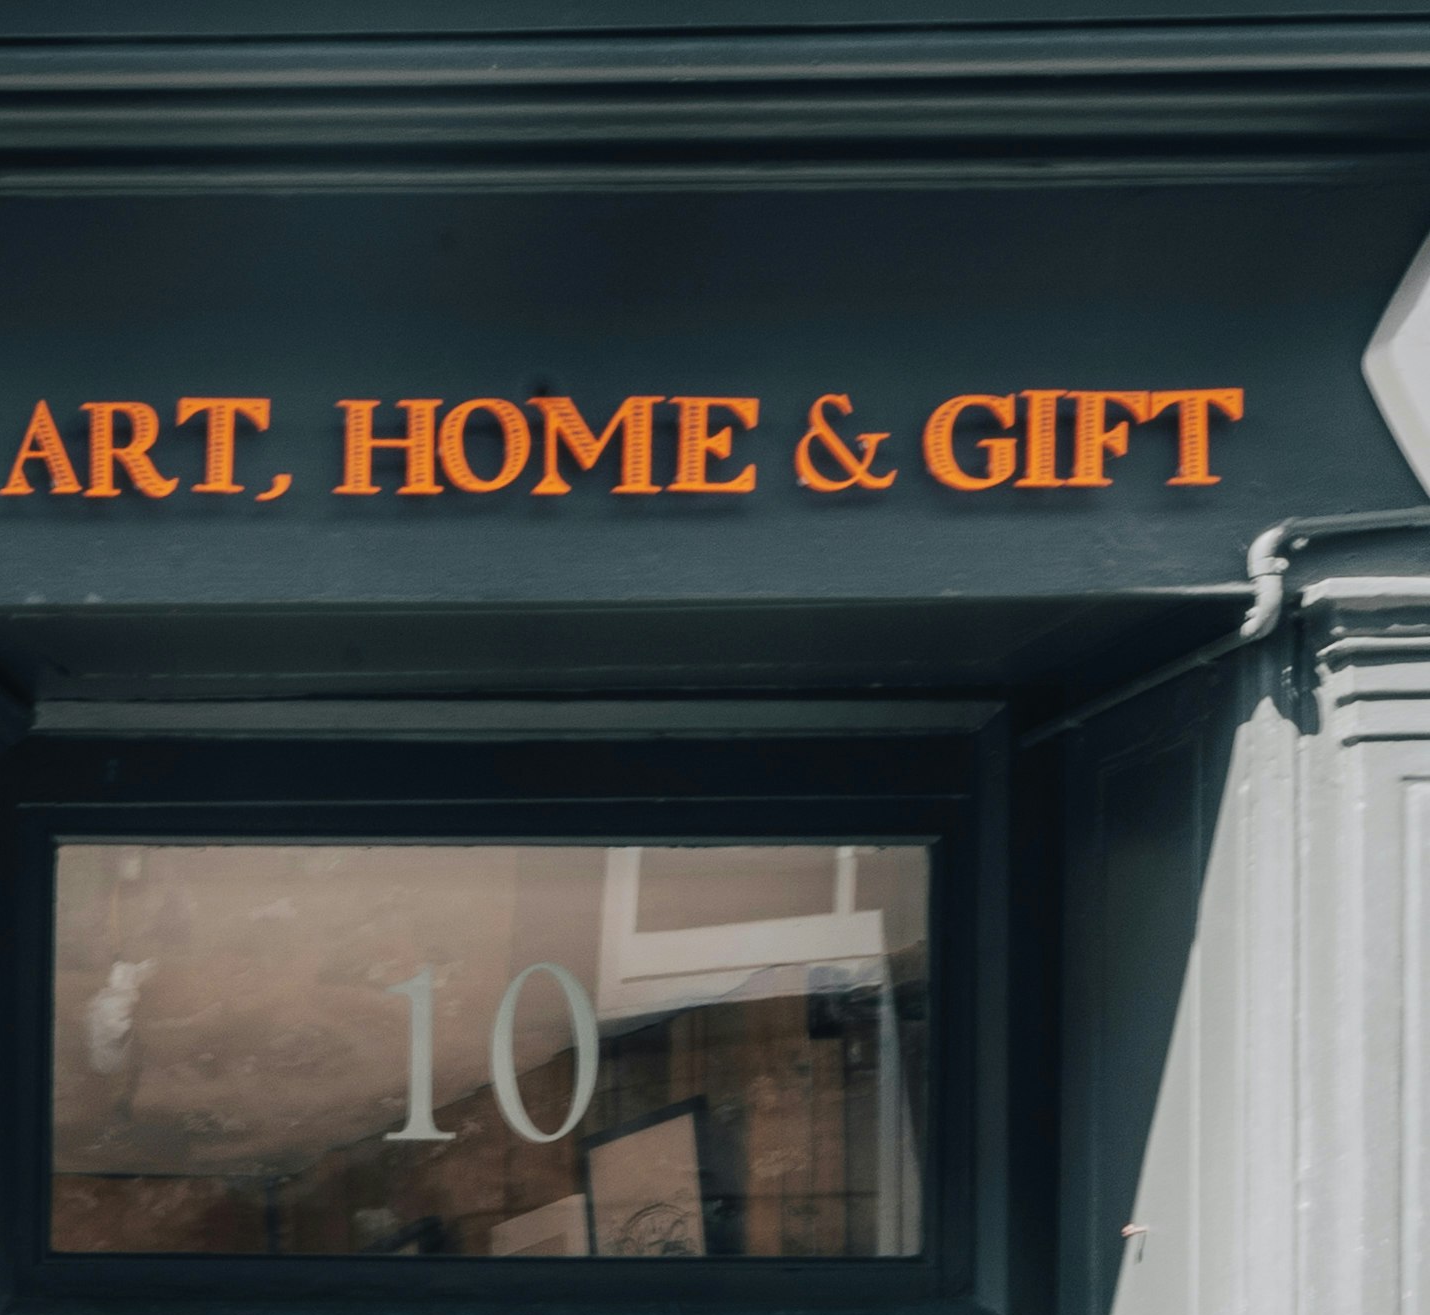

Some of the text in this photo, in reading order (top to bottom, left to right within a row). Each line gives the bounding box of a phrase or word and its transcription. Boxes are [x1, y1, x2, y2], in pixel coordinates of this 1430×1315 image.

[0, 386, 1245, 502] ART, HOME & GIFT
[384, 961, 601, 1144] 10
